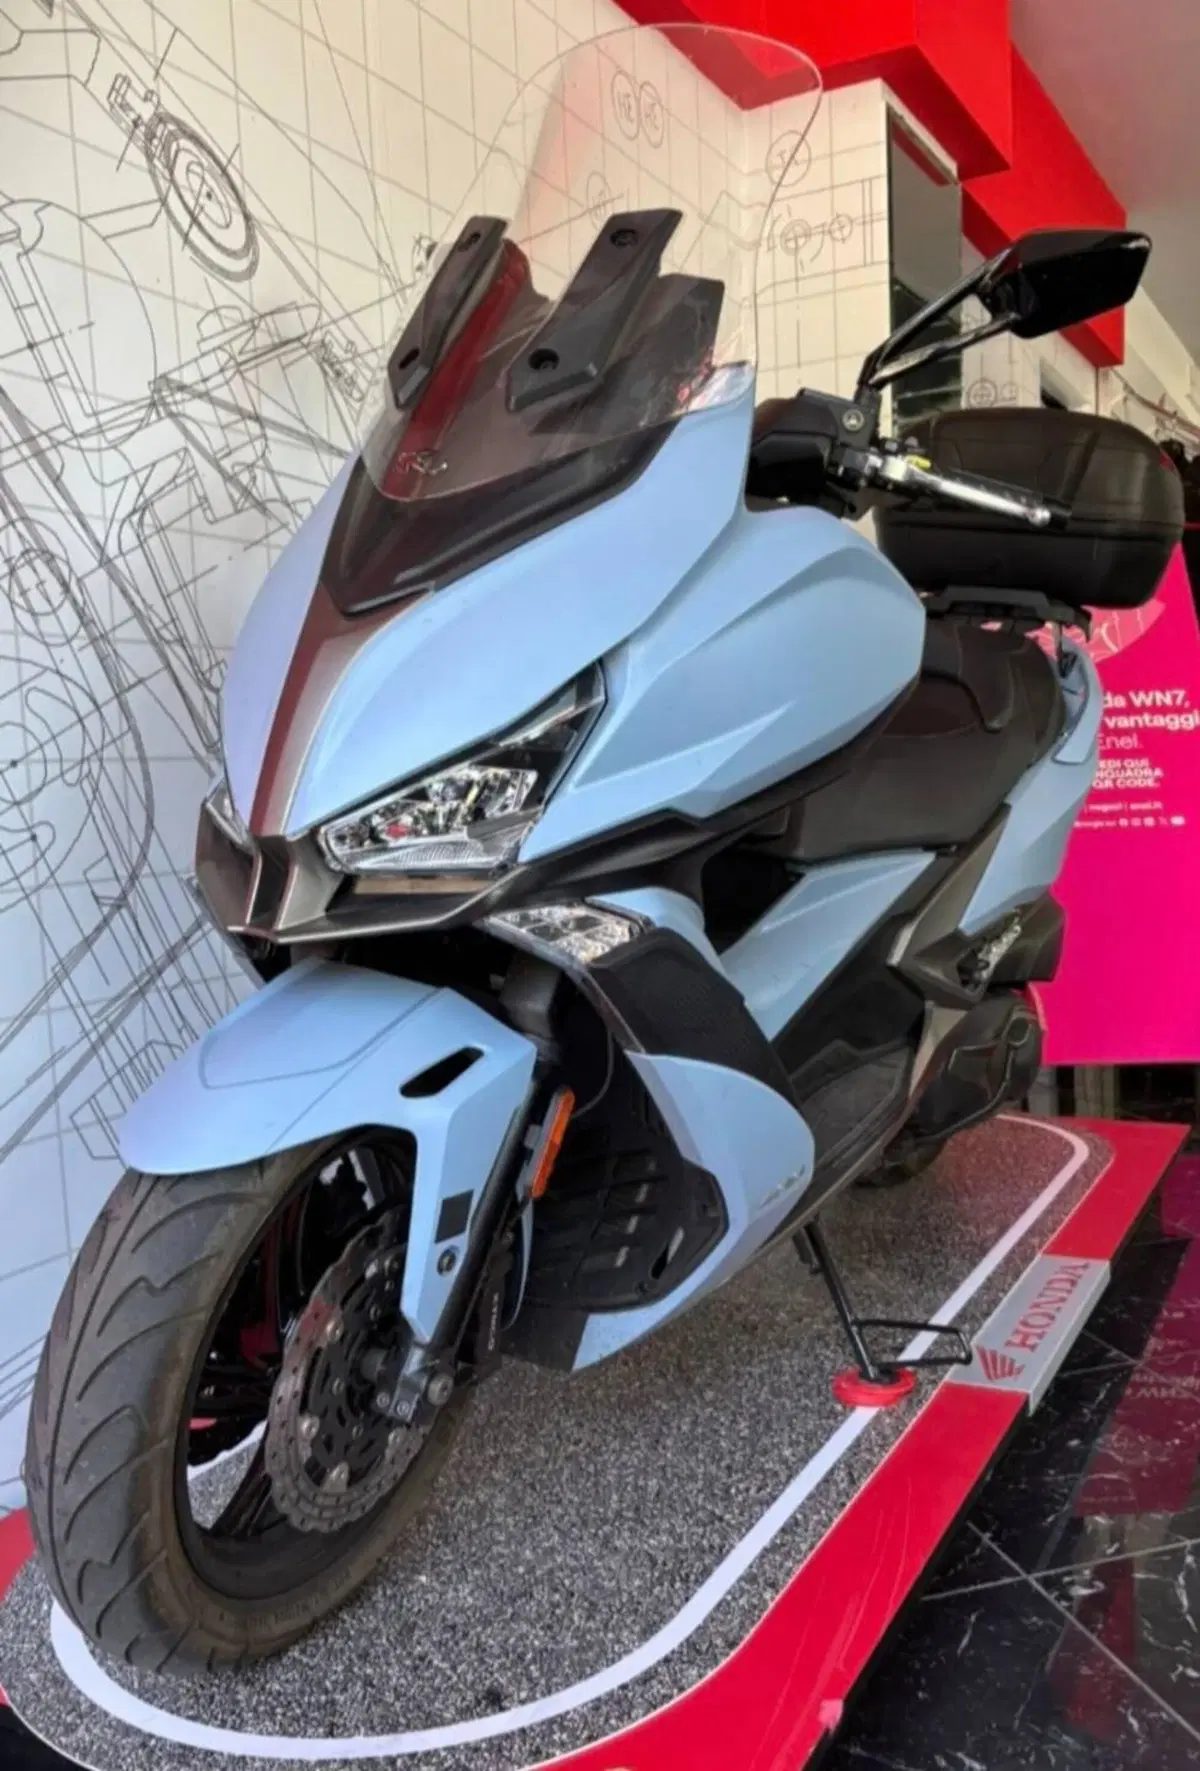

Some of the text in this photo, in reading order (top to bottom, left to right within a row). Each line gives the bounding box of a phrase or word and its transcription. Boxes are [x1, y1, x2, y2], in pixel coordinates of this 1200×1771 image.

[1128, 689, 1191, 708] WN7,
[1103, 709, 1200, 731] vantaggi
[1004, 1262, 1090, 1353] HONDA
